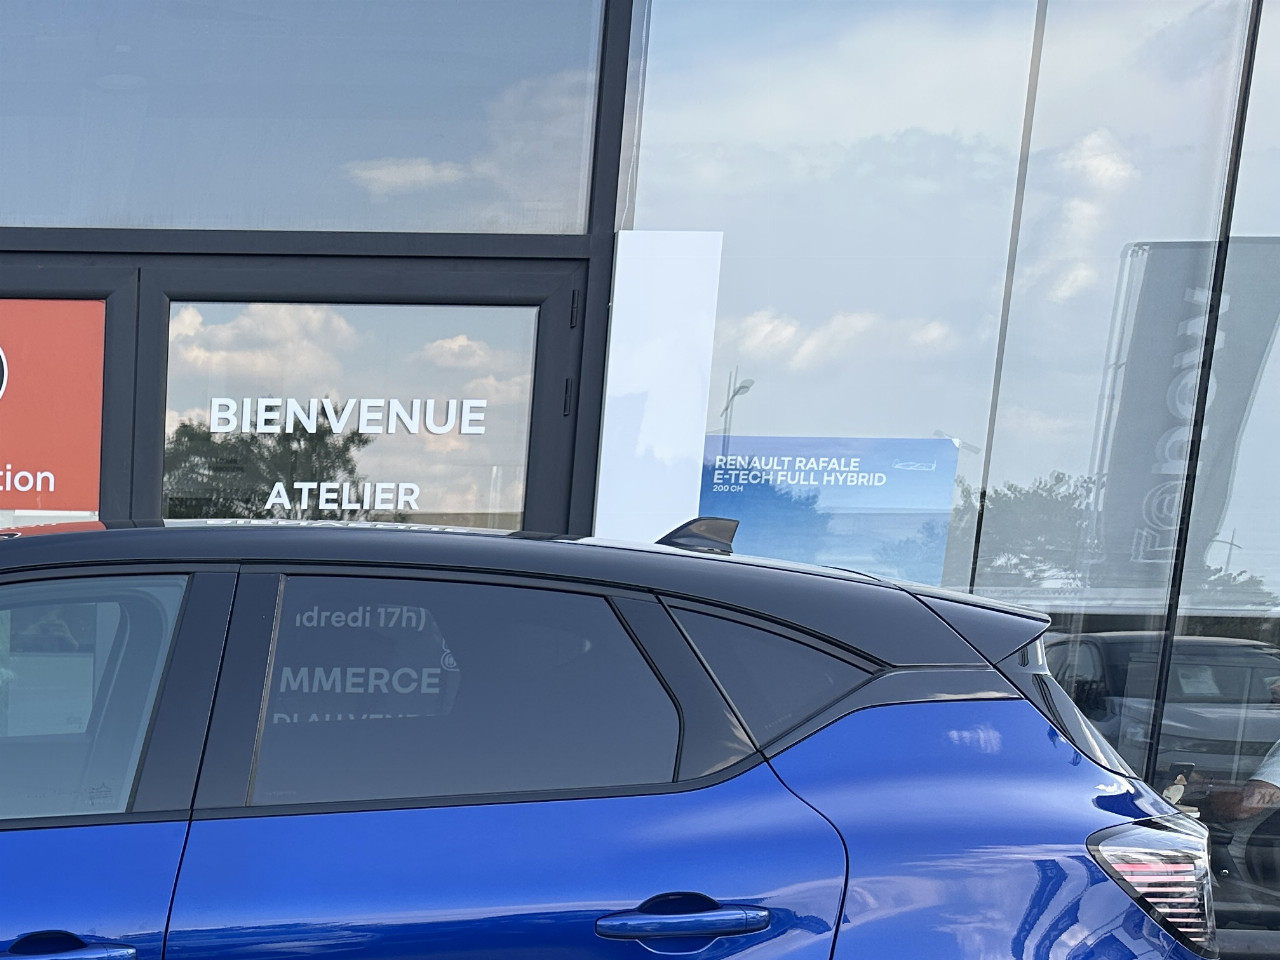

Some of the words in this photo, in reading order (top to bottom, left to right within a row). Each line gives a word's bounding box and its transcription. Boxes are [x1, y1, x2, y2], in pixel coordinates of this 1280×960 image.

[209, 397, 487, 434] BIENVENUE
[715, 455, 792, 470] RENAULT
[795, 457, 860, 471] RAFALE
[713, 470, 773, 484] E-TECH
[776, 471, 819, 485] FULL
[823, 472, 887, 486] HYBRID
[264, 481, 420, 510] ATELIER
[377, 606, 426, 632] 17h)
[280, 666, 441, 694] MMERCE
